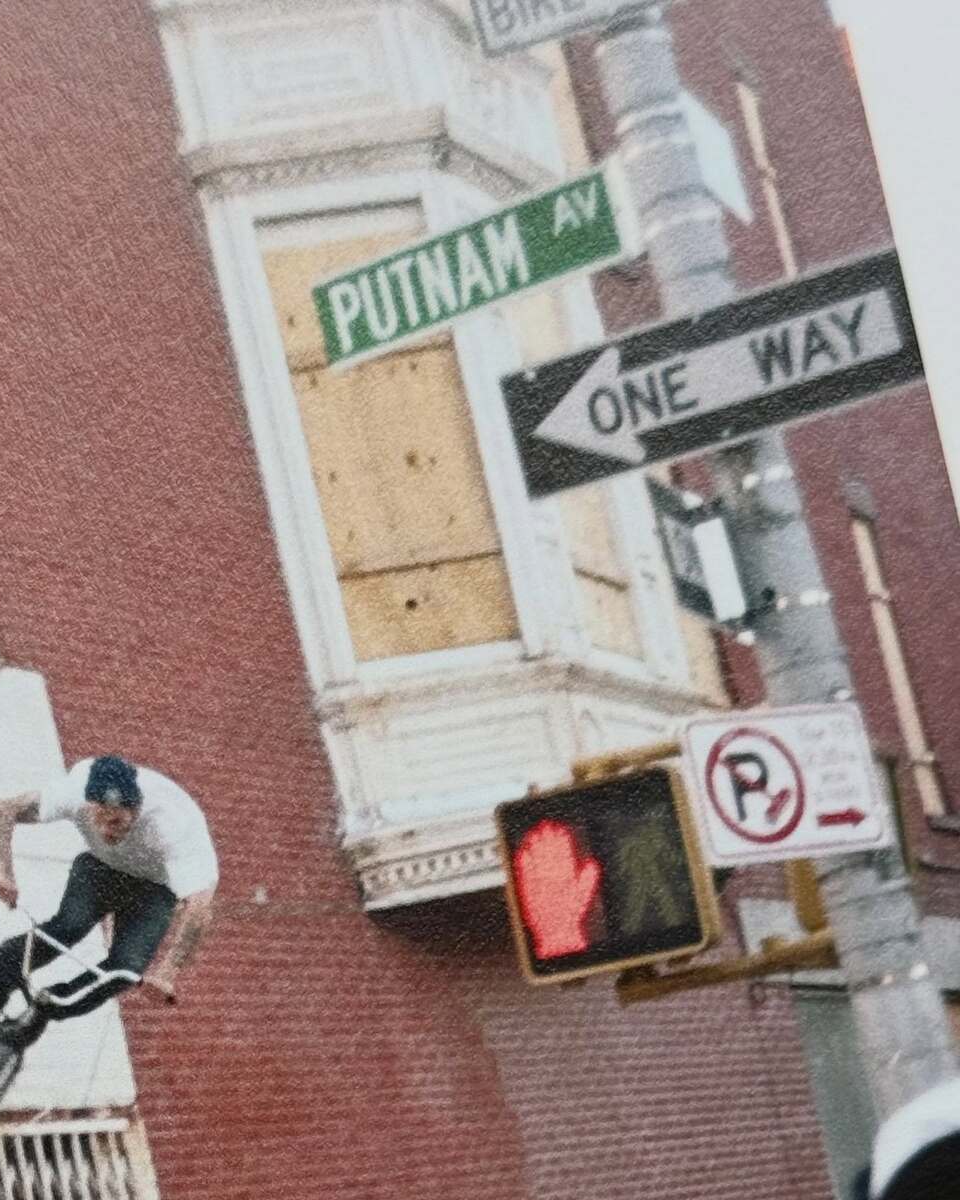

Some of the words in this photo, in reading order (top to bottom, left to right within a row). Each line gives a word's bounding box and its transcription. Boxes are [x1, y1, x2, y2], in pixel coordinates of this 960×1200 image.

[489, 0, 583, 35] BI
[327, 213, 530, 351] PUTNAM
[553, 180, 597, 237] AV
[587, 361, 699, 435] ONE
[747, 301, 866, 386] WAY
